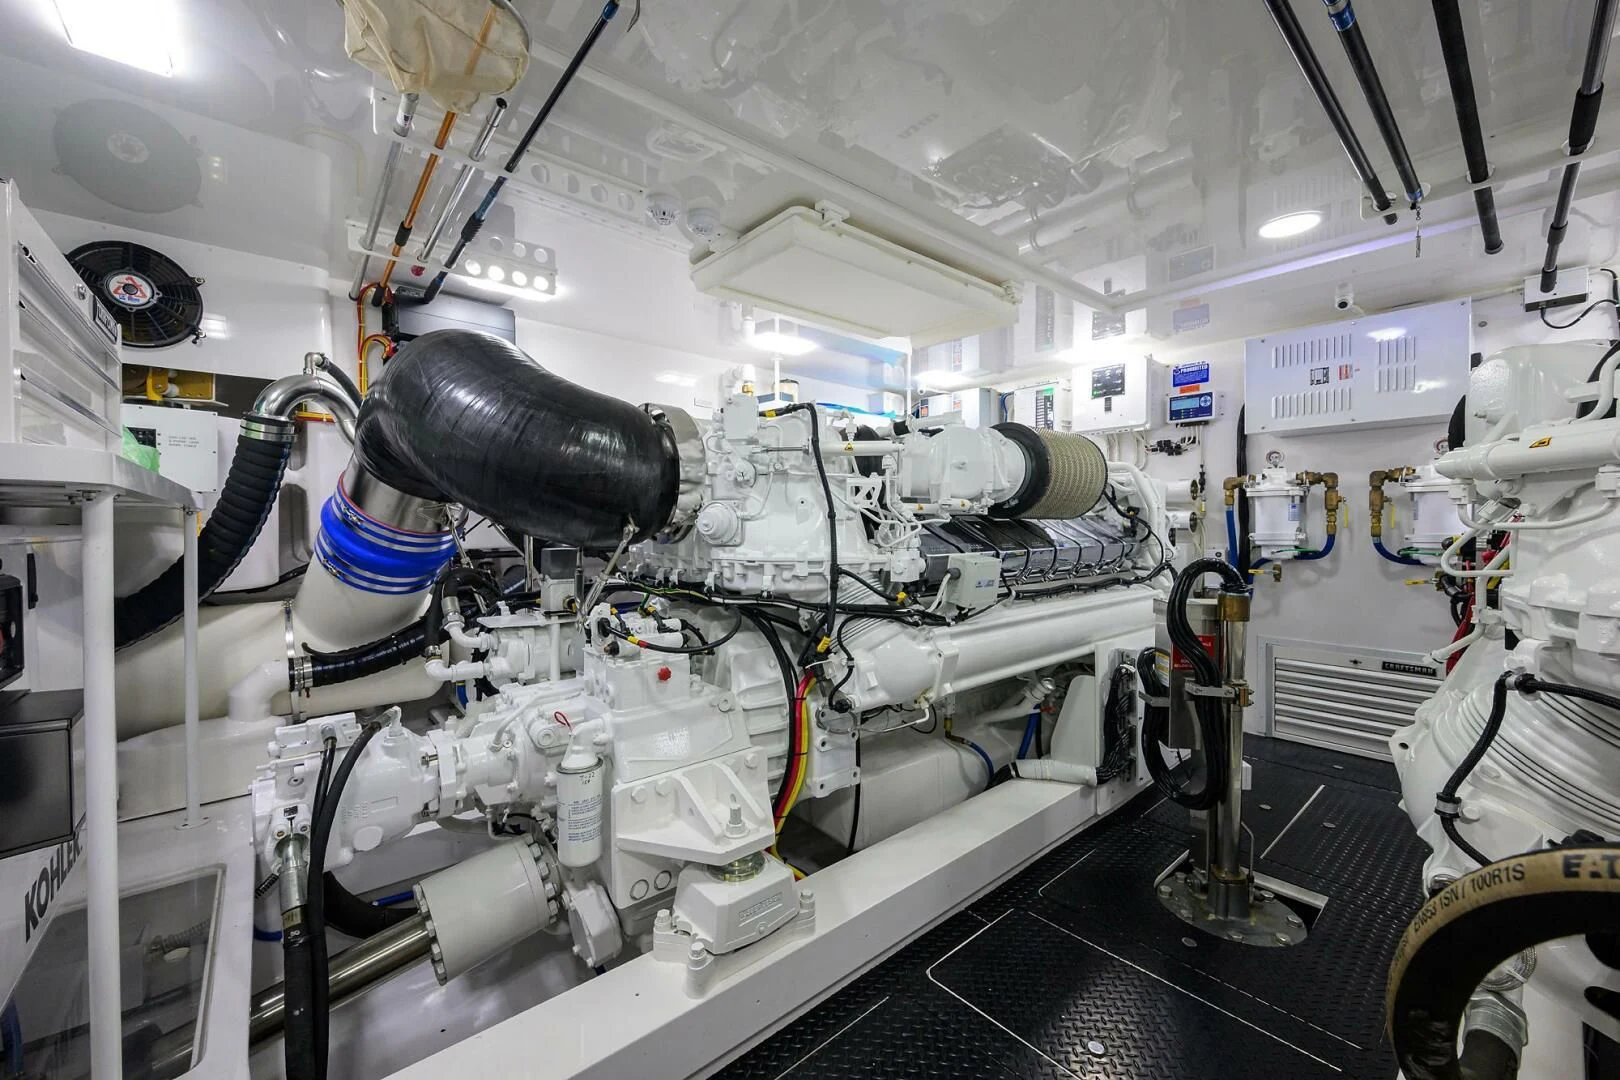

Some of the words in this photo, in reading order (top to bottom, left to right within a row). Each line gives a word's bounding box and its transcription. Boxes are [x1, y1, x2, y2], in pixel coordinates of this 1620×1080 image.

[1384, 663, 1433, 674] CRAFTSMAN
[24, 836, 81, 943] KOHLER
[1472, 863, 1526, 892] 100R1S
